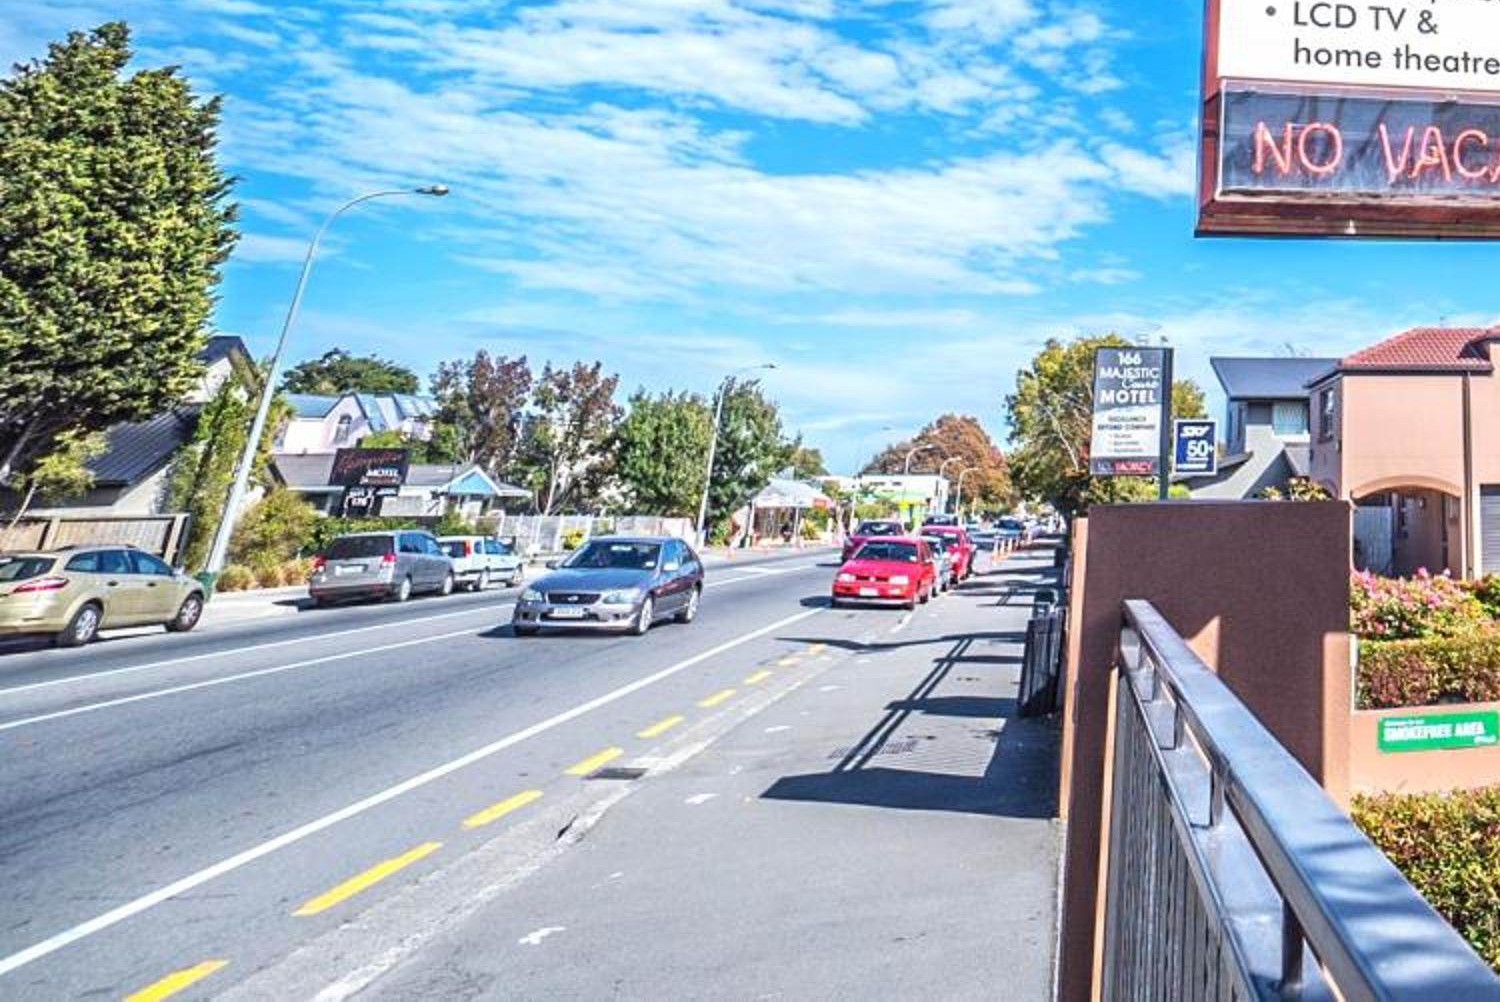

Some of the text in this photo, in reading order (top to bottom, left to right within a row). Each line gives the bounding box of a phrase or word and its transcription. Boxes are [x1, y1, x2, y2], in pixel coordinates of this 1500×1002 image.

[1293, 1, 1439, 35] LCD TV &
[1293, 38, 1382, 68] home
[1393, 43, 1500, 76] theatre
[1252, 120, 1344, 176] NO
[1118, 351, 1143, 365] 166
[1100, 367, 1160, 379] MAJESTIC
[1100, 389, 1156, 404] MOTEL
